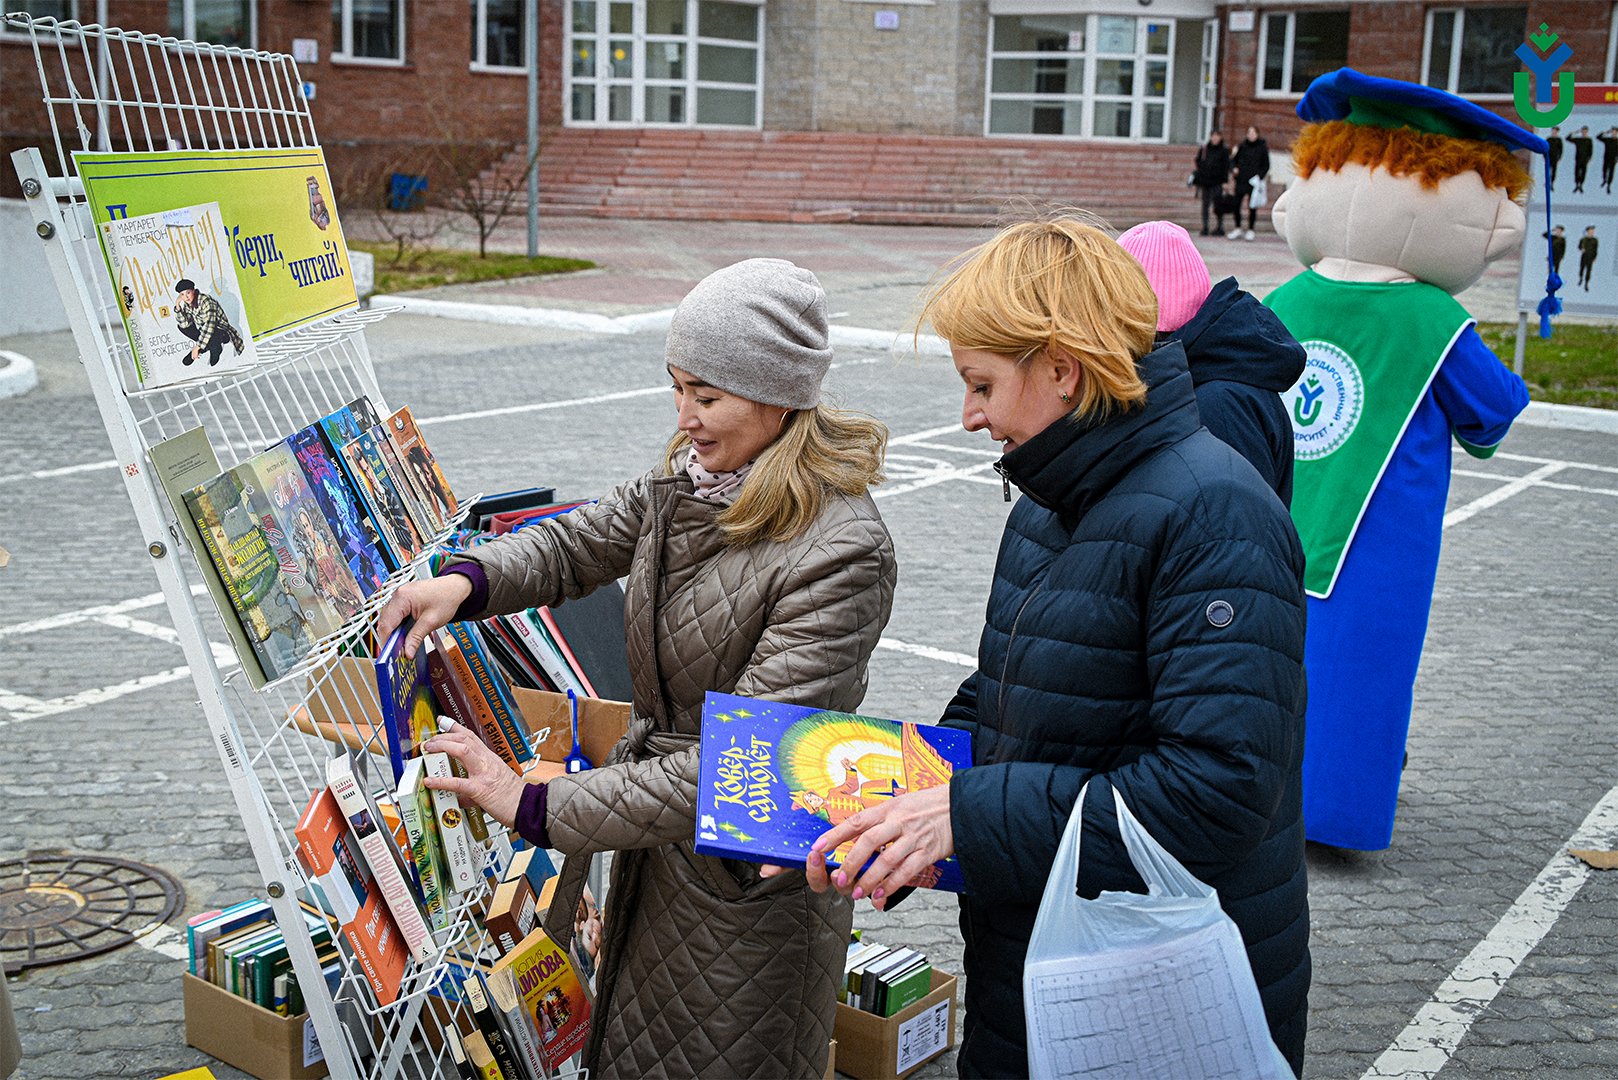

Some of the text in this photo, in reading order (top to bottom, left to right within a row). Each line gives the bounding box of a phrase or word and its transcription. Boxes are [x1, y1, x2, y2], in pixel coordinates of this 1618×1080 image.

[116, 217, 157, 234] МАРГАРЕТ
[120, 228, 170, 247] ПЕМБЕРТОН
[233, 224, 285, 278] бери,
[288, 240, 345, 288] читай!
[148, 333, 171, 348] БЕЛОЕ
[151, 340, 196, 358] РОЖДЕСТВО
[1305, 359, 1346, 421] ОСУДАРСТВЕННЫЙ
[1294, 426, 1328, 442] ЕРСИТЕТ
[469, 652, 527, 755] ГЕОИНФОРМАЦИОННЫЕ
[483, 720, 513, 764] ВИРИНЕЯ
[745, 734, 778, 823] самолёт
[363, 835, 428, 949] ЧИНГИЗ АЙТМАТОВ
[410, 828, 443, 915] ЛЮДМИЛА УЛИЦКАЯ
[349, 930, 384, 993] При свете ночника
